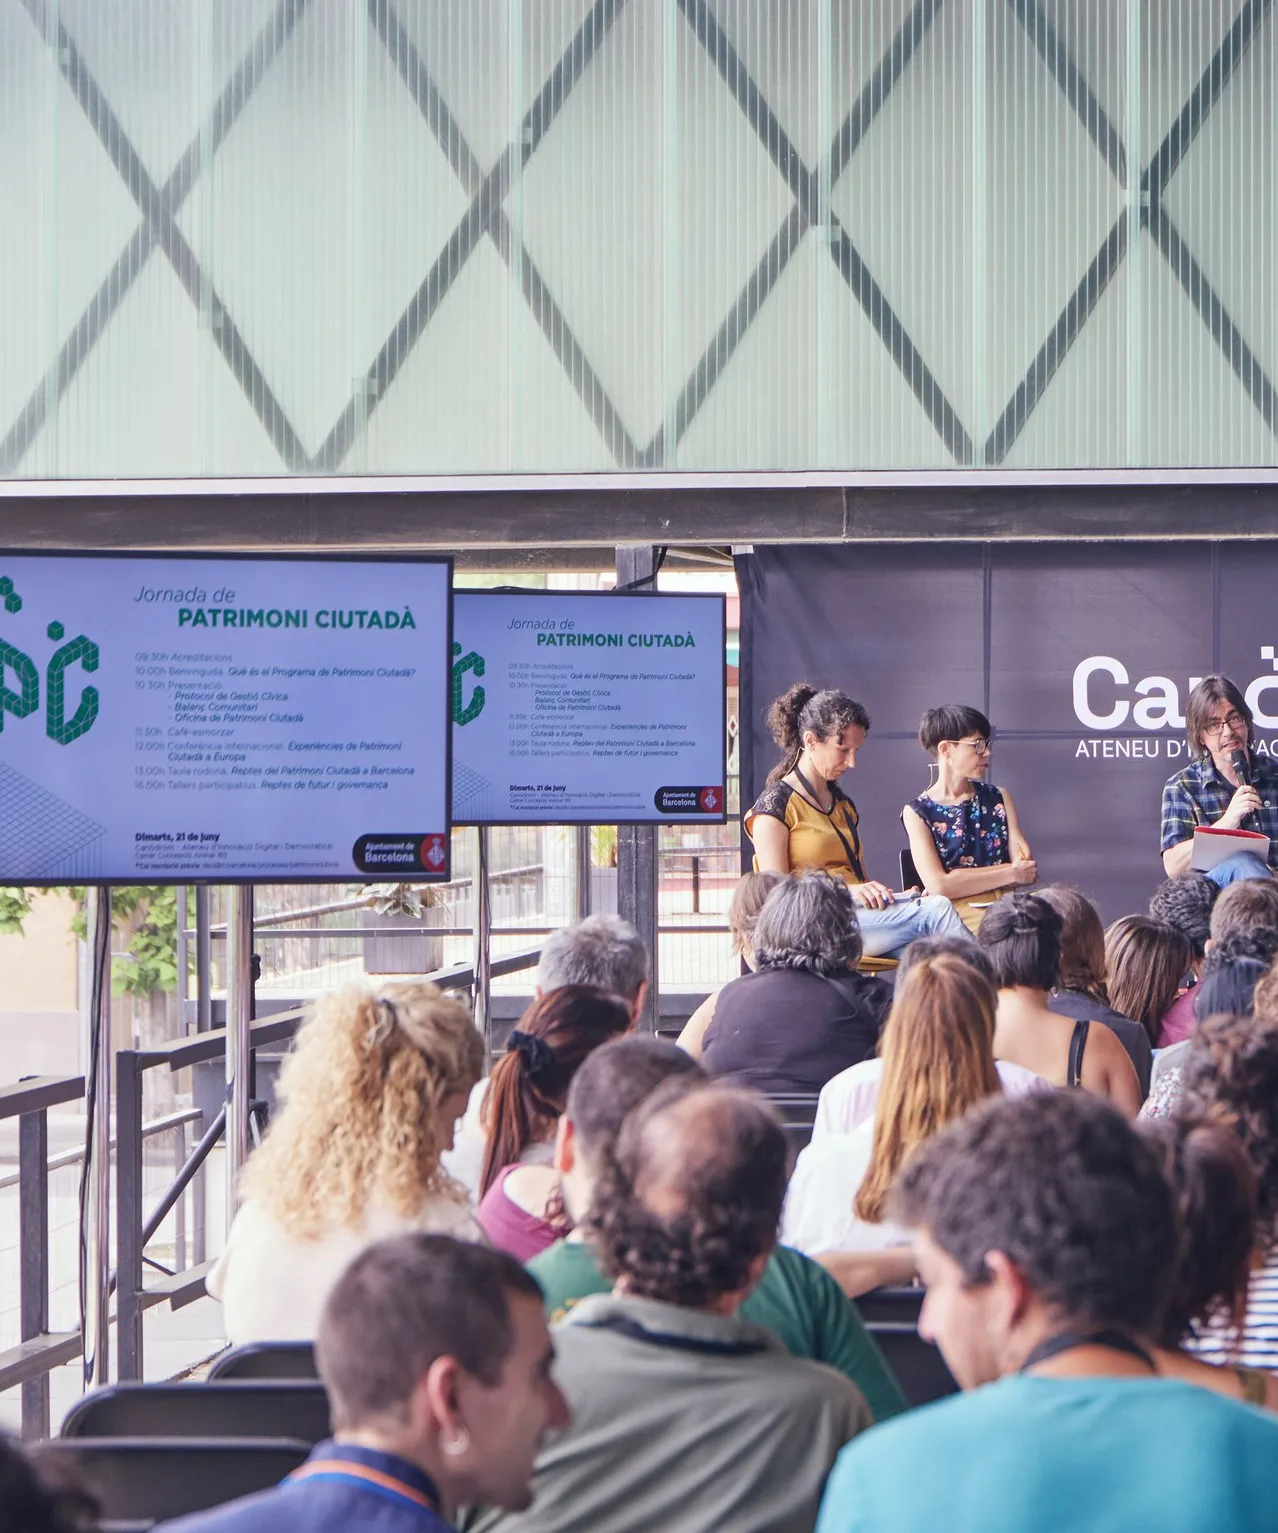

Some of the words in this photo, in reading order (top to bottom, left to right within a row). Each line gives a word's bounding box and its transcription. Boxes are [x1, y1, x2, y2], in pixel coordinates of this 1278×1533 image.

[133, 585, 207, 603] Jornada
[213, 585, 235, 603] de
[178, 608, 308, 628] PATRIMONI
[315, 605, 416, 629] CIUTADÀ
[507, 618, 556, 630] Jornada
[560, 618, 575, 630] de
[537, 633, 623, 647] PATRIMONI
[628, 631, 696, 648] CIUTADÀ
[271, 667, 316, 678] Programa
[318, 667, 329, 678] de
[332, 667, 374, 678] Patrimoni
[600, 673, 629, 681] Programa
[174, 691, 214, 701] Protocol
[216, 691, 228, 701] de
[230, 691, 259, 701] Gestió
[261, 691, 288, 701] Cívica
[174, 702, 205, 713] Balanç
[207, 702, 258, 712] Comunitari
[175, 713, 207, 722] Oficina
[209, 713, 221, 722] de
[223, 713, 267, 722] Patrimoni
[269, 713, 304, 723] Ciutadà
[346, 741, 357, 751] de
[359, 741, 402, 751] Patrimoni
[1075, 739, 1159, 758] ATENEU
[168, 752, 203, 762] Ciutadà
[205, 754, 212, 762] a
[213, 752, 246, 762] Europa
[231, 766, 262, 776] Reptes
[264, 766, 280, 776] del
[281, 766, 325, 776] Patrimoni
[370, 766, 415, 776] Barcelona
[261, 780, 292, 791] Reptes
[294, 780, 306, 791] de
[307, 780, 330, 791] futur
[135, 832, 174, 842] Dimarts,
[176, 832, 186, 842] 21
[187, 832, 199, 842] de
[200, 832, 220, 842] juny
[365, 842, 405, 852] Ajuntament
[365, 852, 415, 863] Barcelona
